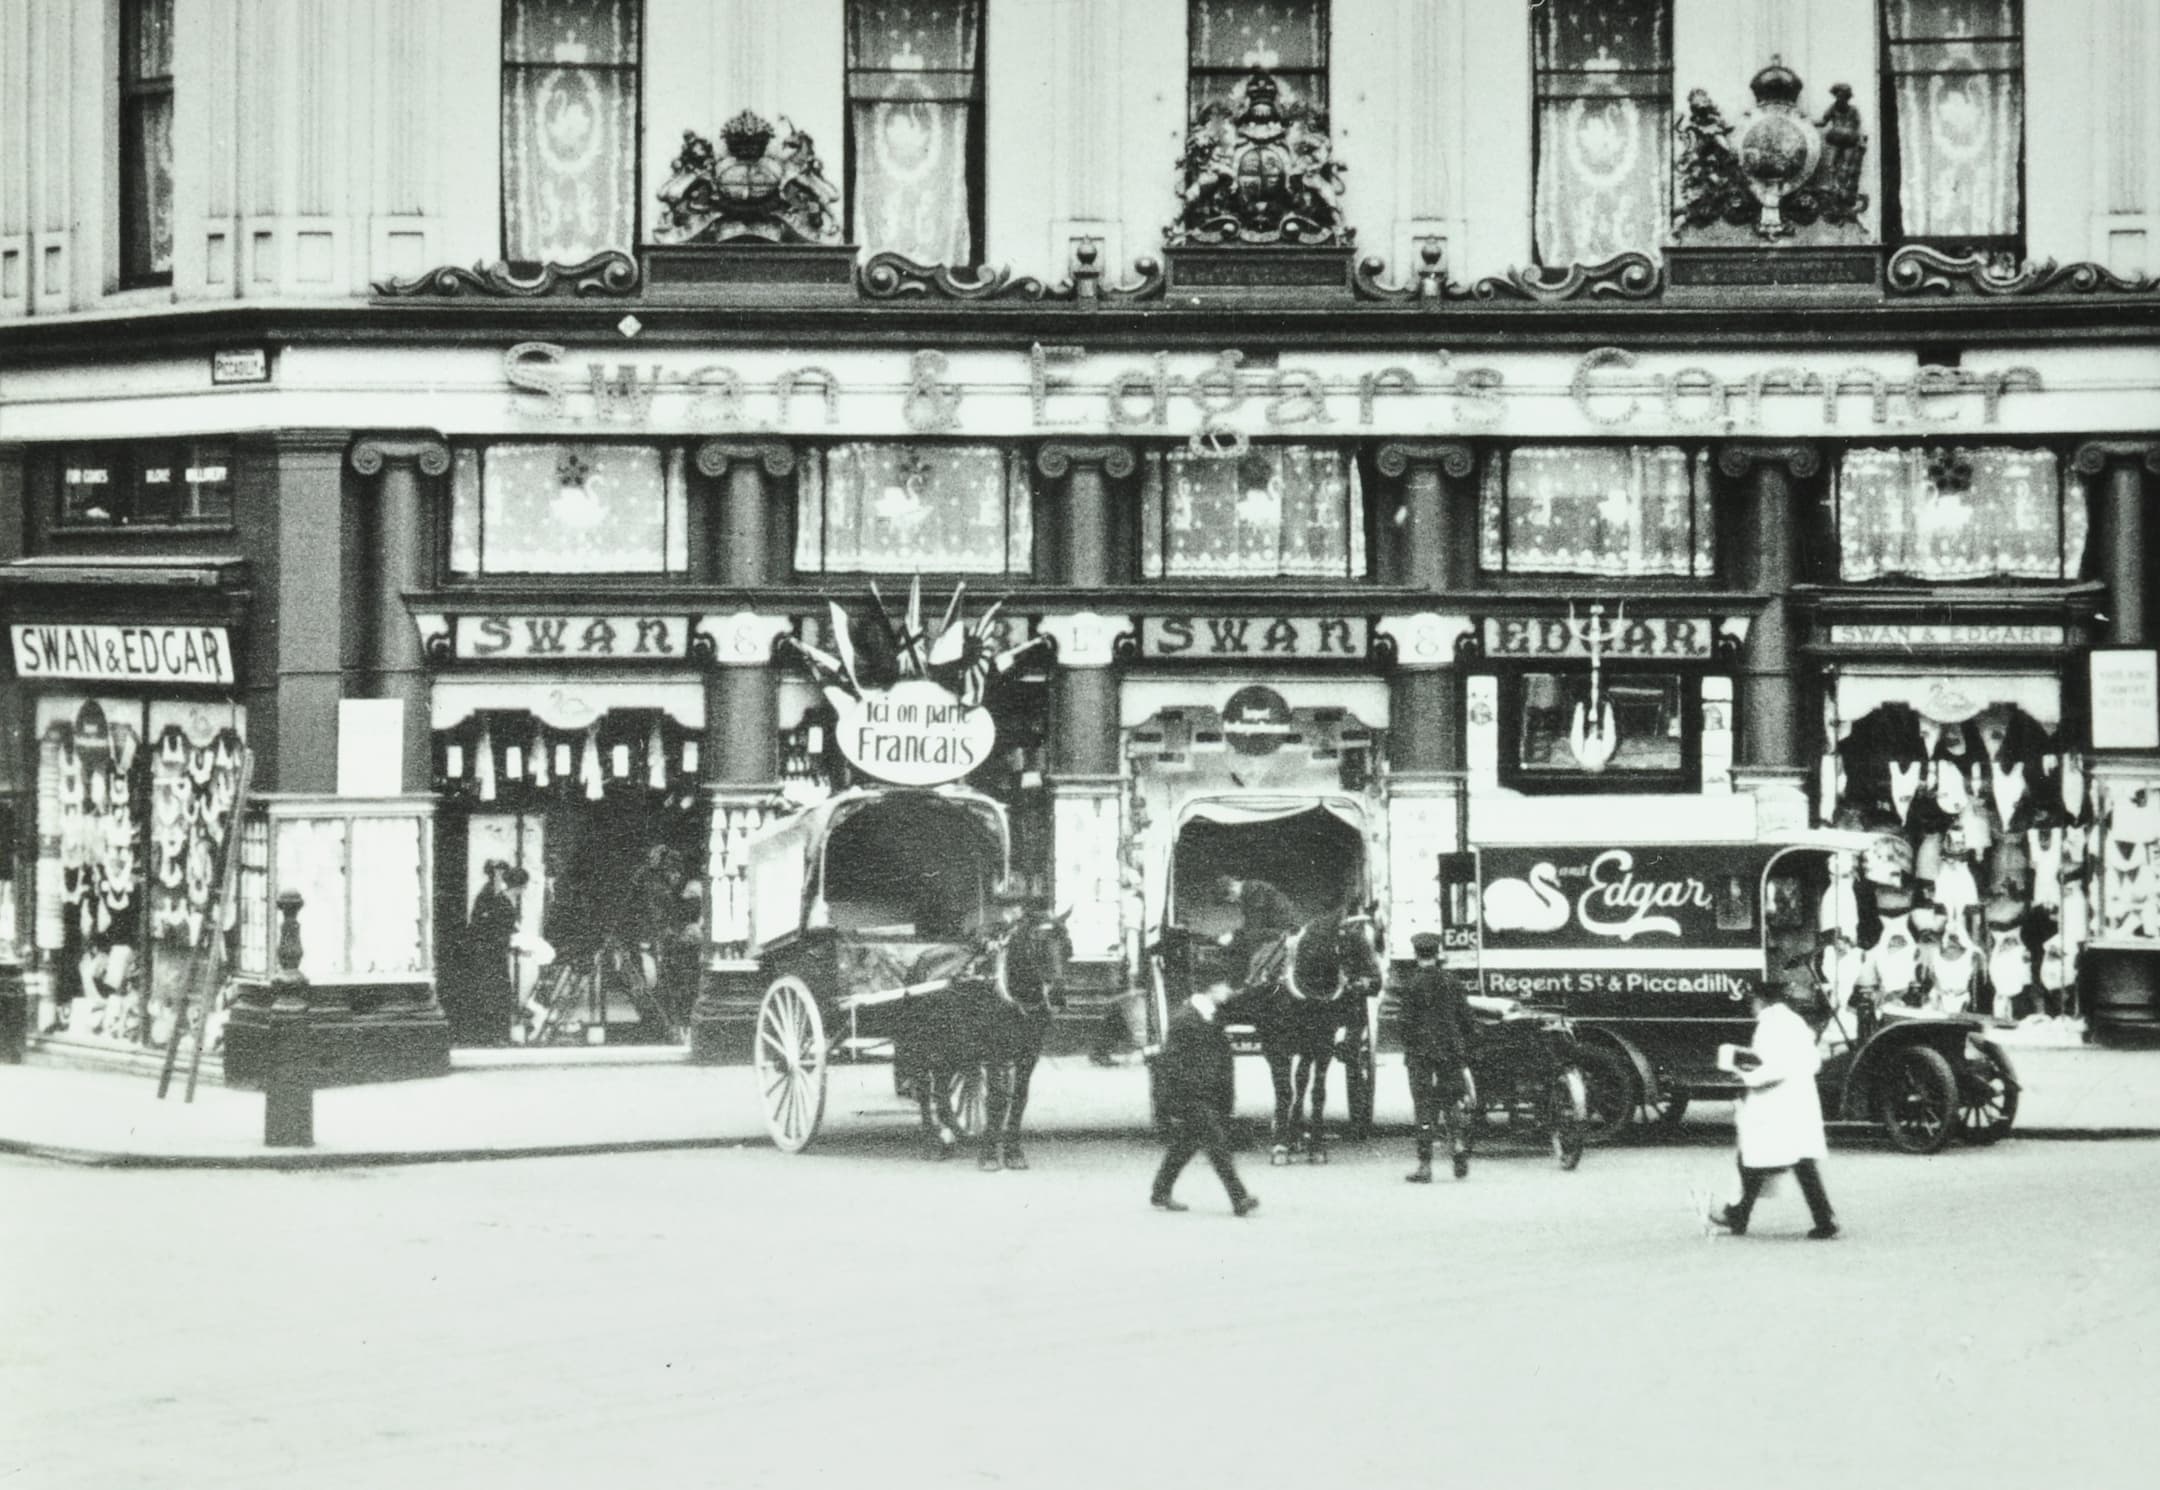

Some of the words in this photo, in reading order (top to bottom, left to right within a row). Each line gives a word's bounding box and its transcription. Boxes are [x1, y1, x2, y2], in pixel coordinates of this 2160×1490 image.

[503, 342, 841, 426] Swan
[904, 349, 963, 431] &
[1572, 347, 2044, 424] Corner
[867, 696, 889, 723] Ici
[897, 703, 918, 723] on
[1489, 972, 1574, 998] Regent
[1578, 972, 1604, 992] St
[1607, 976, 1622, 992] &
